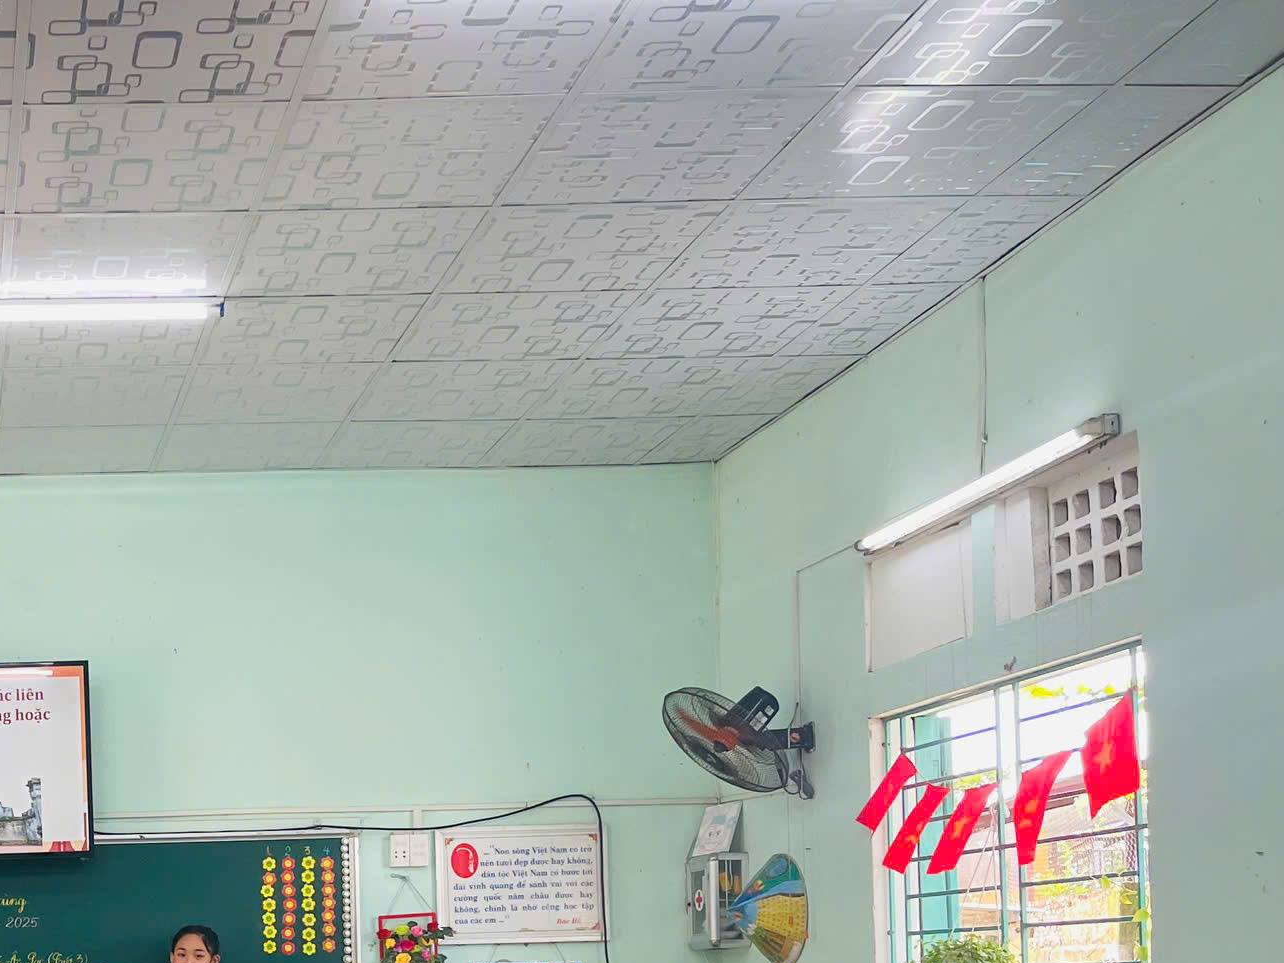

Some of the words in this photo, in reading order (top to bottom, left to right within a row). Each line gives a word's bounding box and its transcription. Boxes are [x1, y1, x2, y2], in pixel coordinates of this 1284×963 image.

[16, 687, 45, 701] liên
[15, 708, 51, 724] hoặc
[5, 916, 40, 928] 2025
